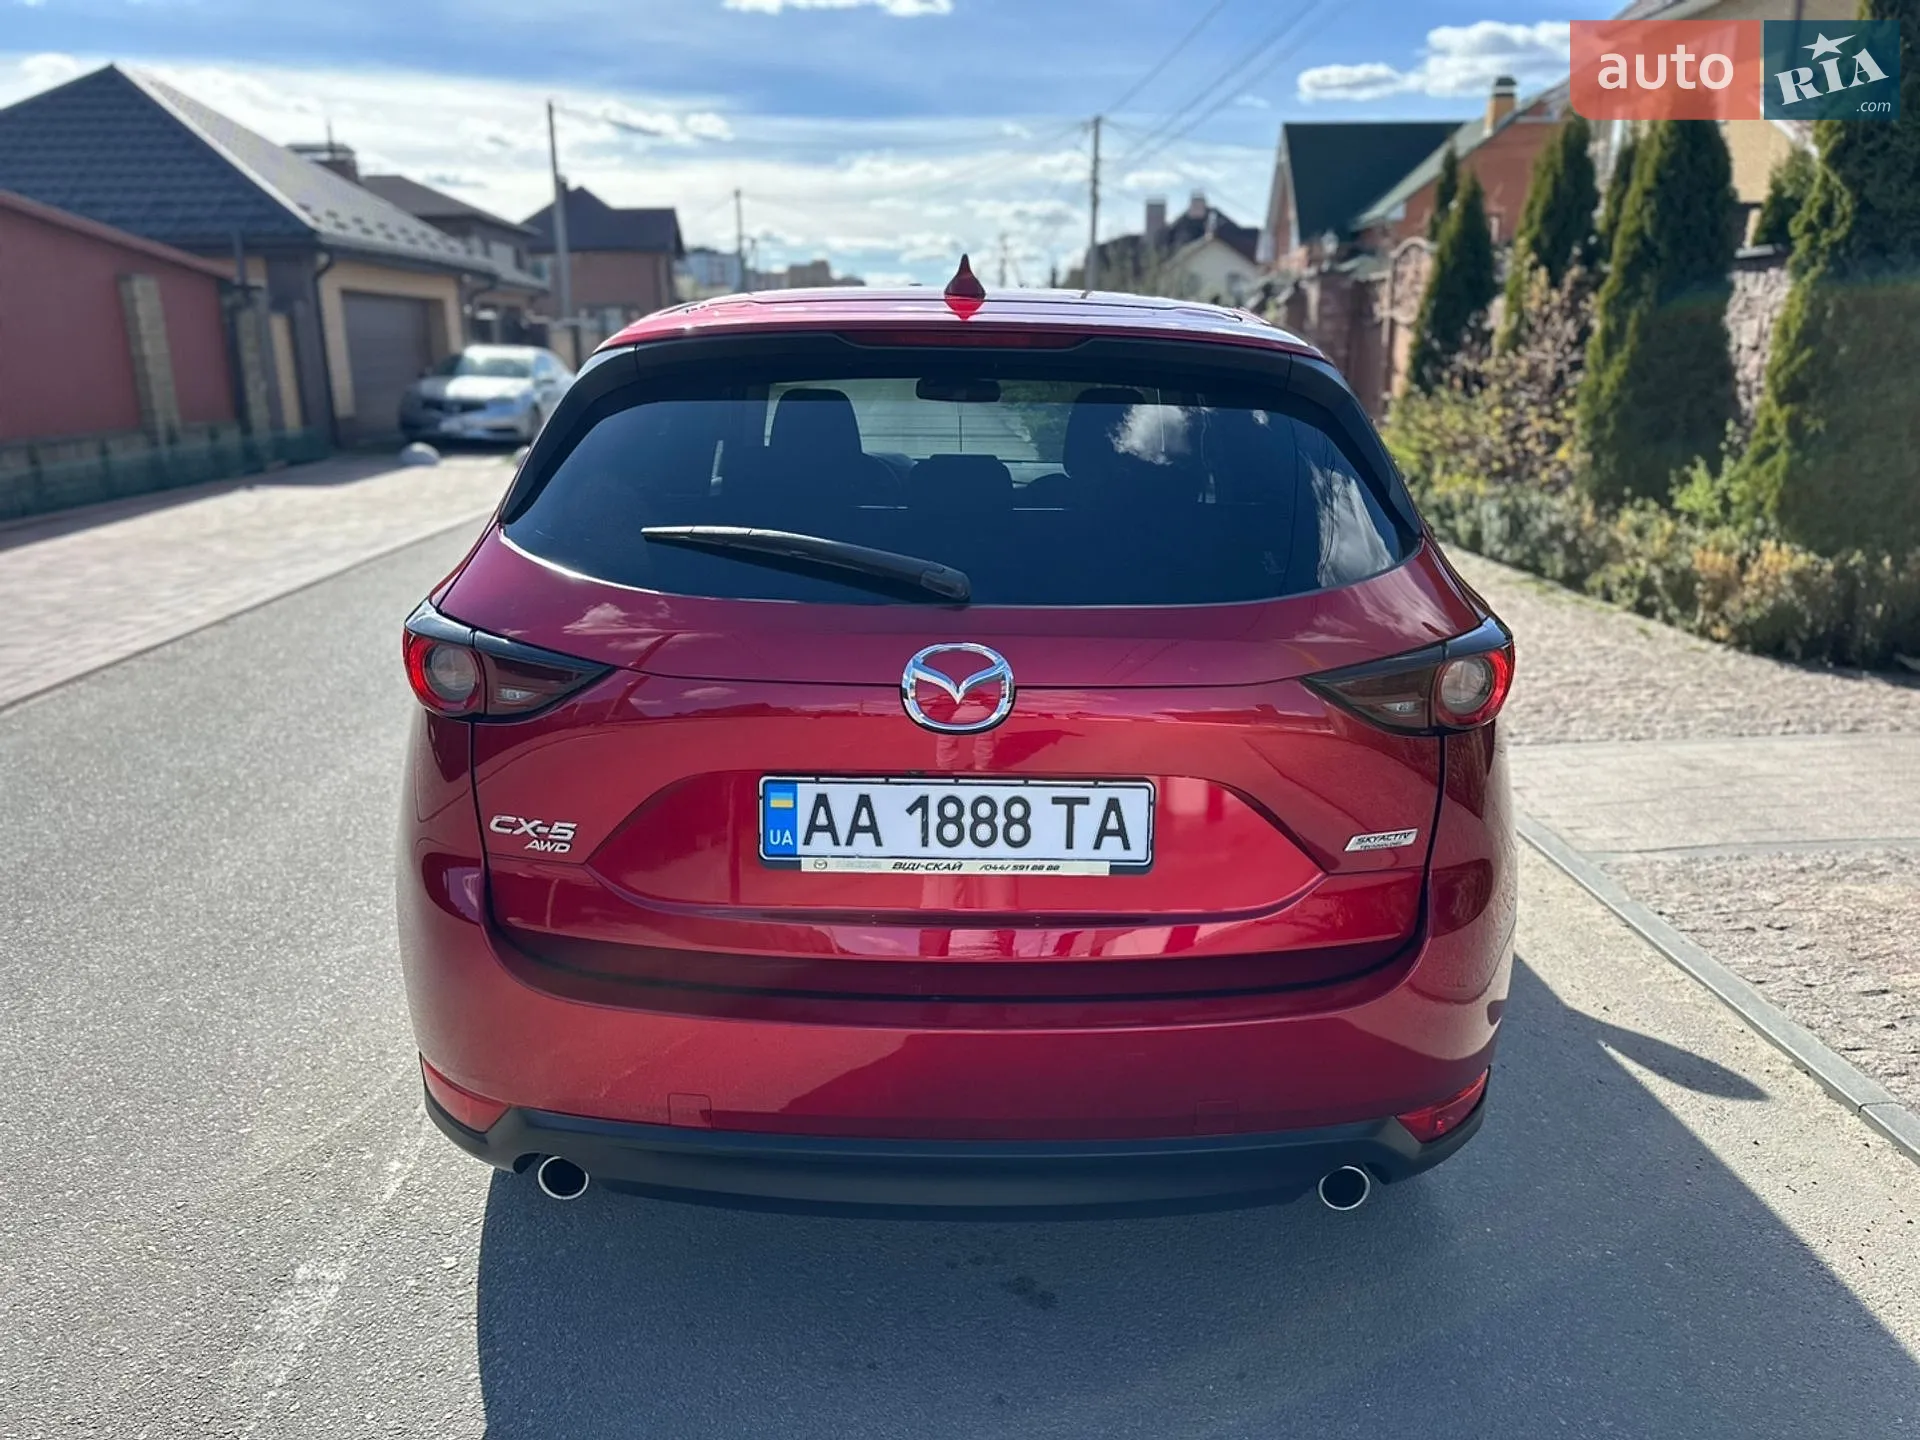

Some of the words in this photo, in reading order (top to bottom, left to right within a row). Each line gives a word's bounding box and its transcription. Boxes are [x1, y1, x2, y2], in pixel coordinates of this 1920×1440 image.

[489, 814, 577, 841] CX-5
[802, 793, 883, 847] AA
[905, 794, 1031, 848] 1888
[1051, 796, 1131, 850] TA
[524, 839, 571, 853] AWD
[769, 829, 793, 846] UA
[1356, 831, 1414, 844] SKYACTIV
